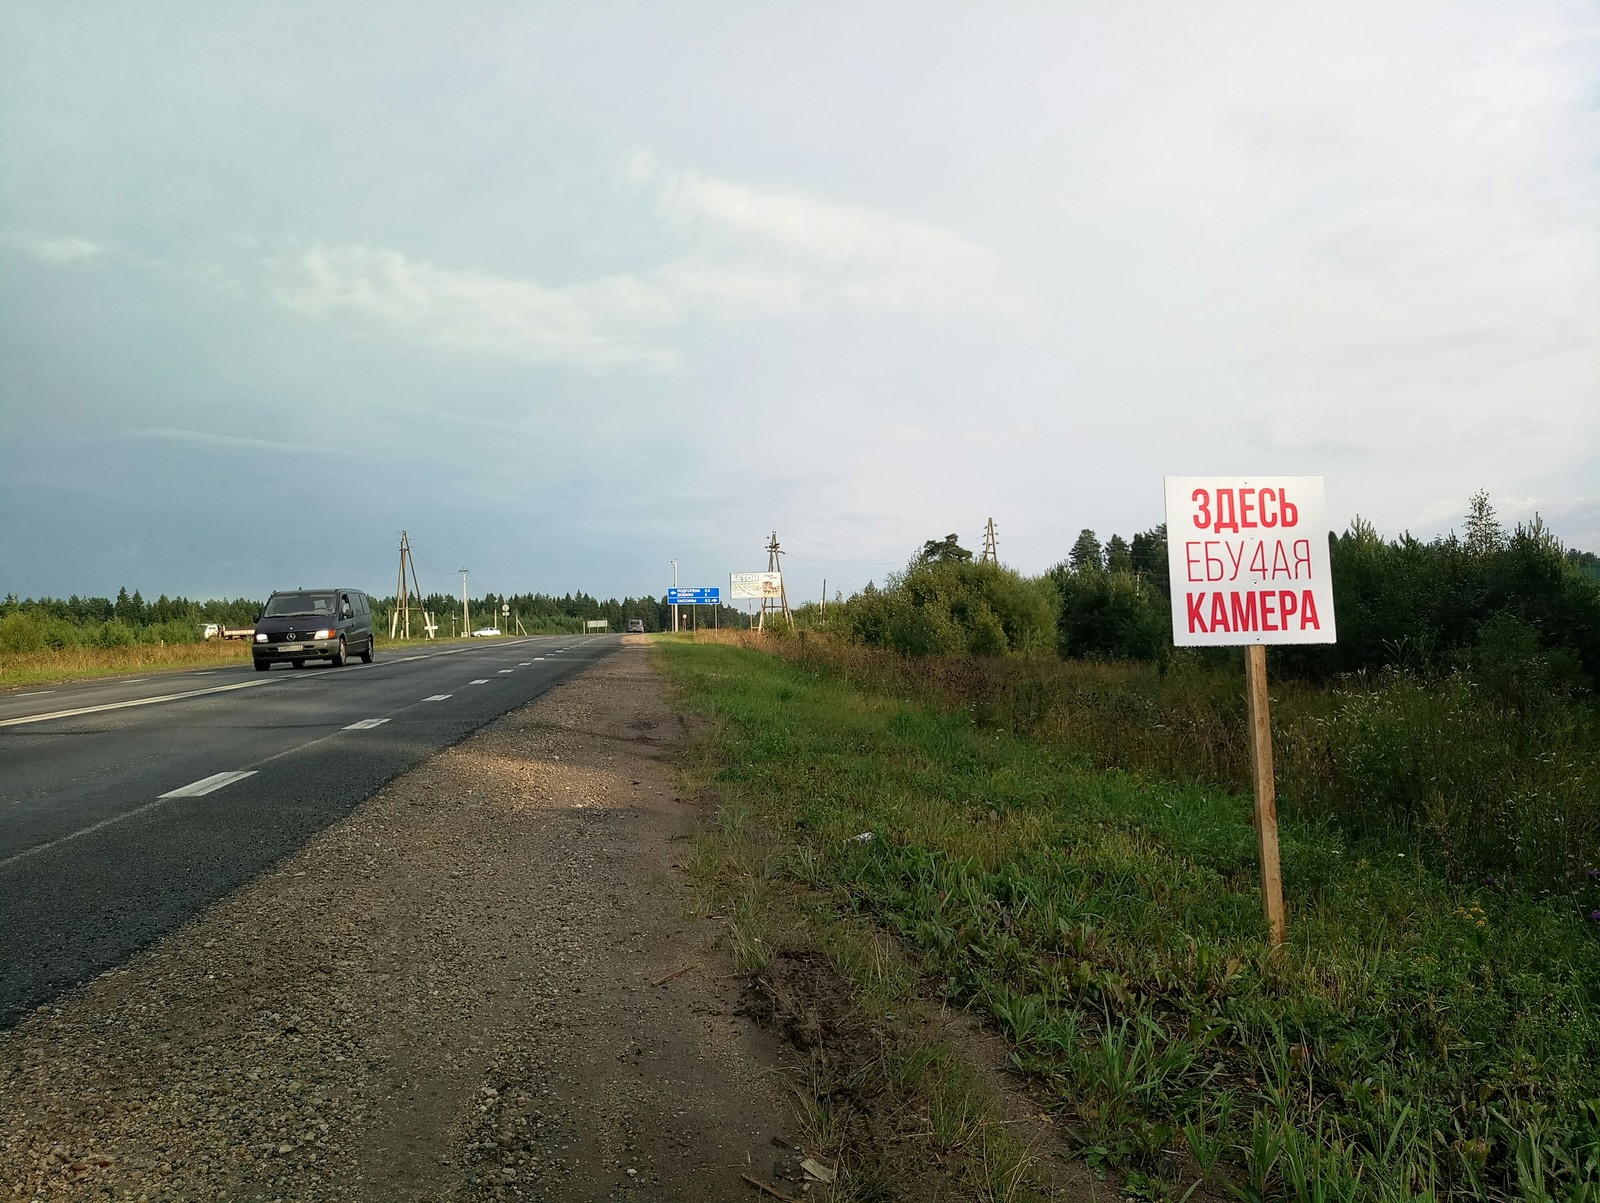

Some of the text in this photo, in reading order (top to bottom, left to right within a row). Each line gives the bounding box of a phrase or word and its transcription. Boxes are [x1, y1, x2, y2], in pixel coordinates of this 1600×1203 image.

[1191, 487, 1298, 534] ЗДЕСЬ
[732, 574, 759, 582] БЕТОН
[1186, 589, 1321, 634] КАМЕРА
